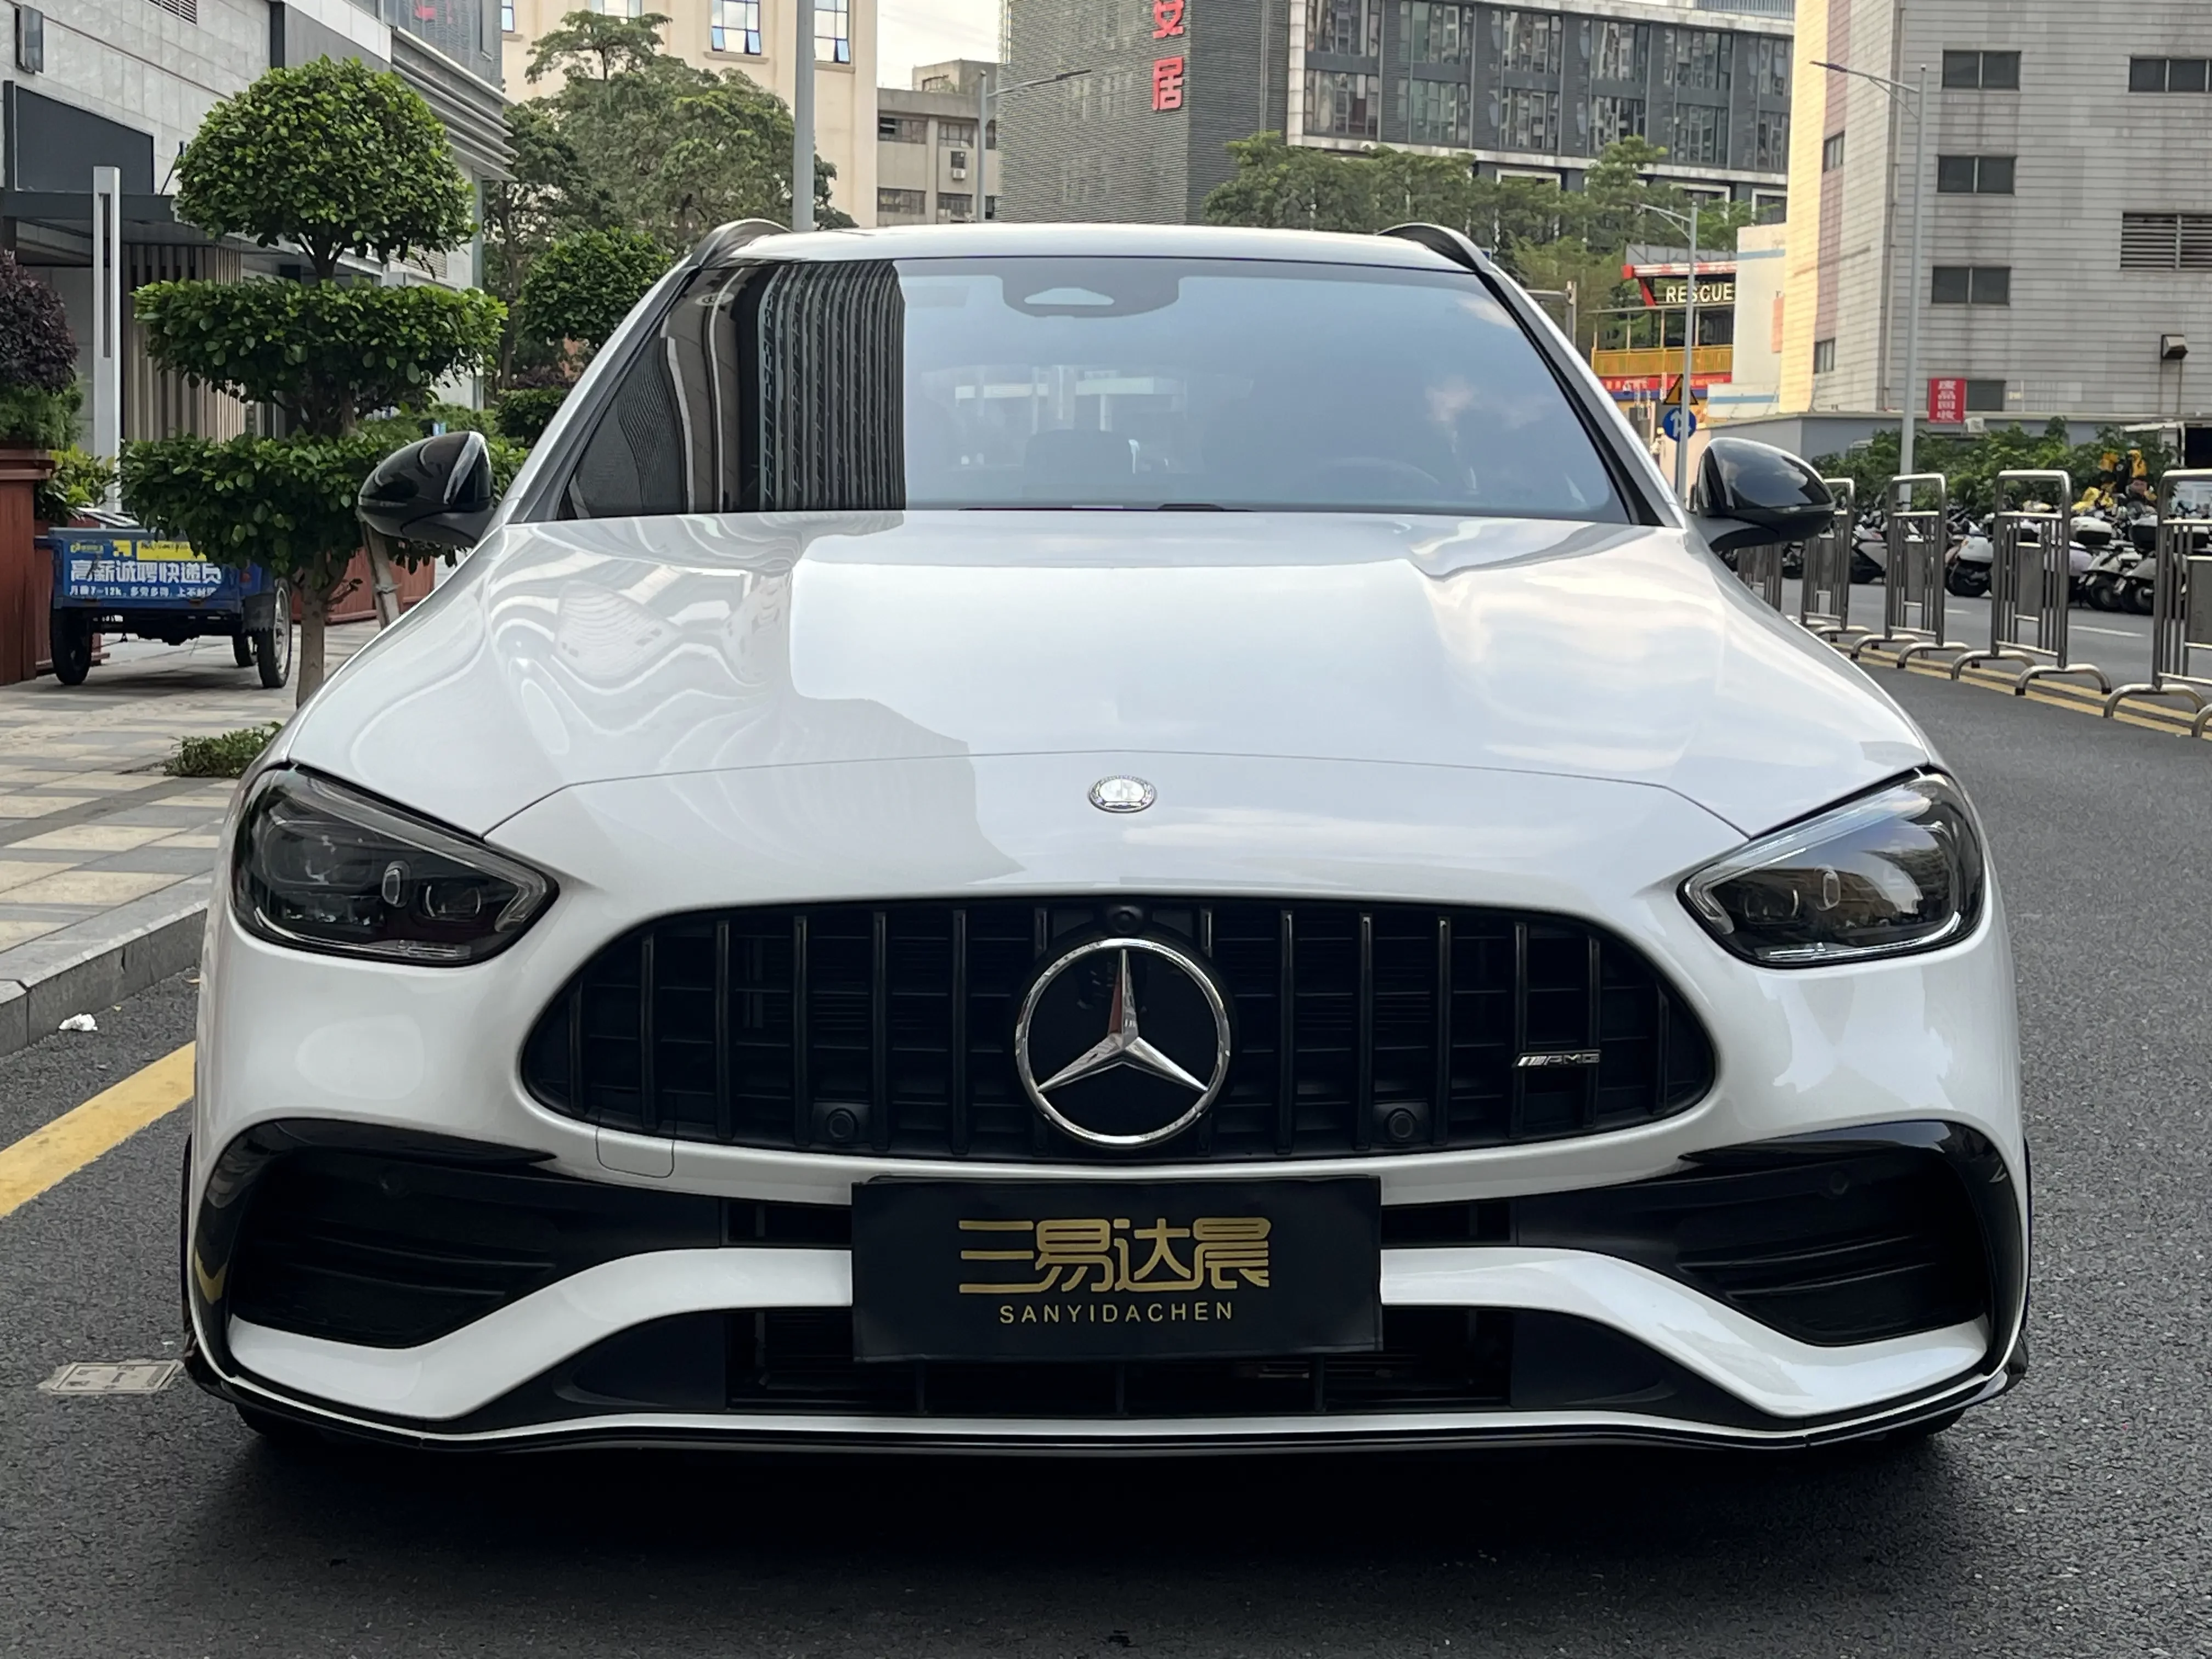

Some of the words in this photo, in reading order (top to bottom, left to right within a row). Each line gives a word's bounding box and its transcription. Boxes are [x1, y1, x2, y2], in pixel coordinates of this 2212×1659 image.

[1666, 283, 1734, 303] RESCUE
[71, 560, 222, 584] 高薪诚聘快递员
[1542, 1053, 1600, 1066] AMG
[959, 1217, 1271, 1294] 三易达晨
[999, 1301, 1233, 1324] SANYIDACHEN
